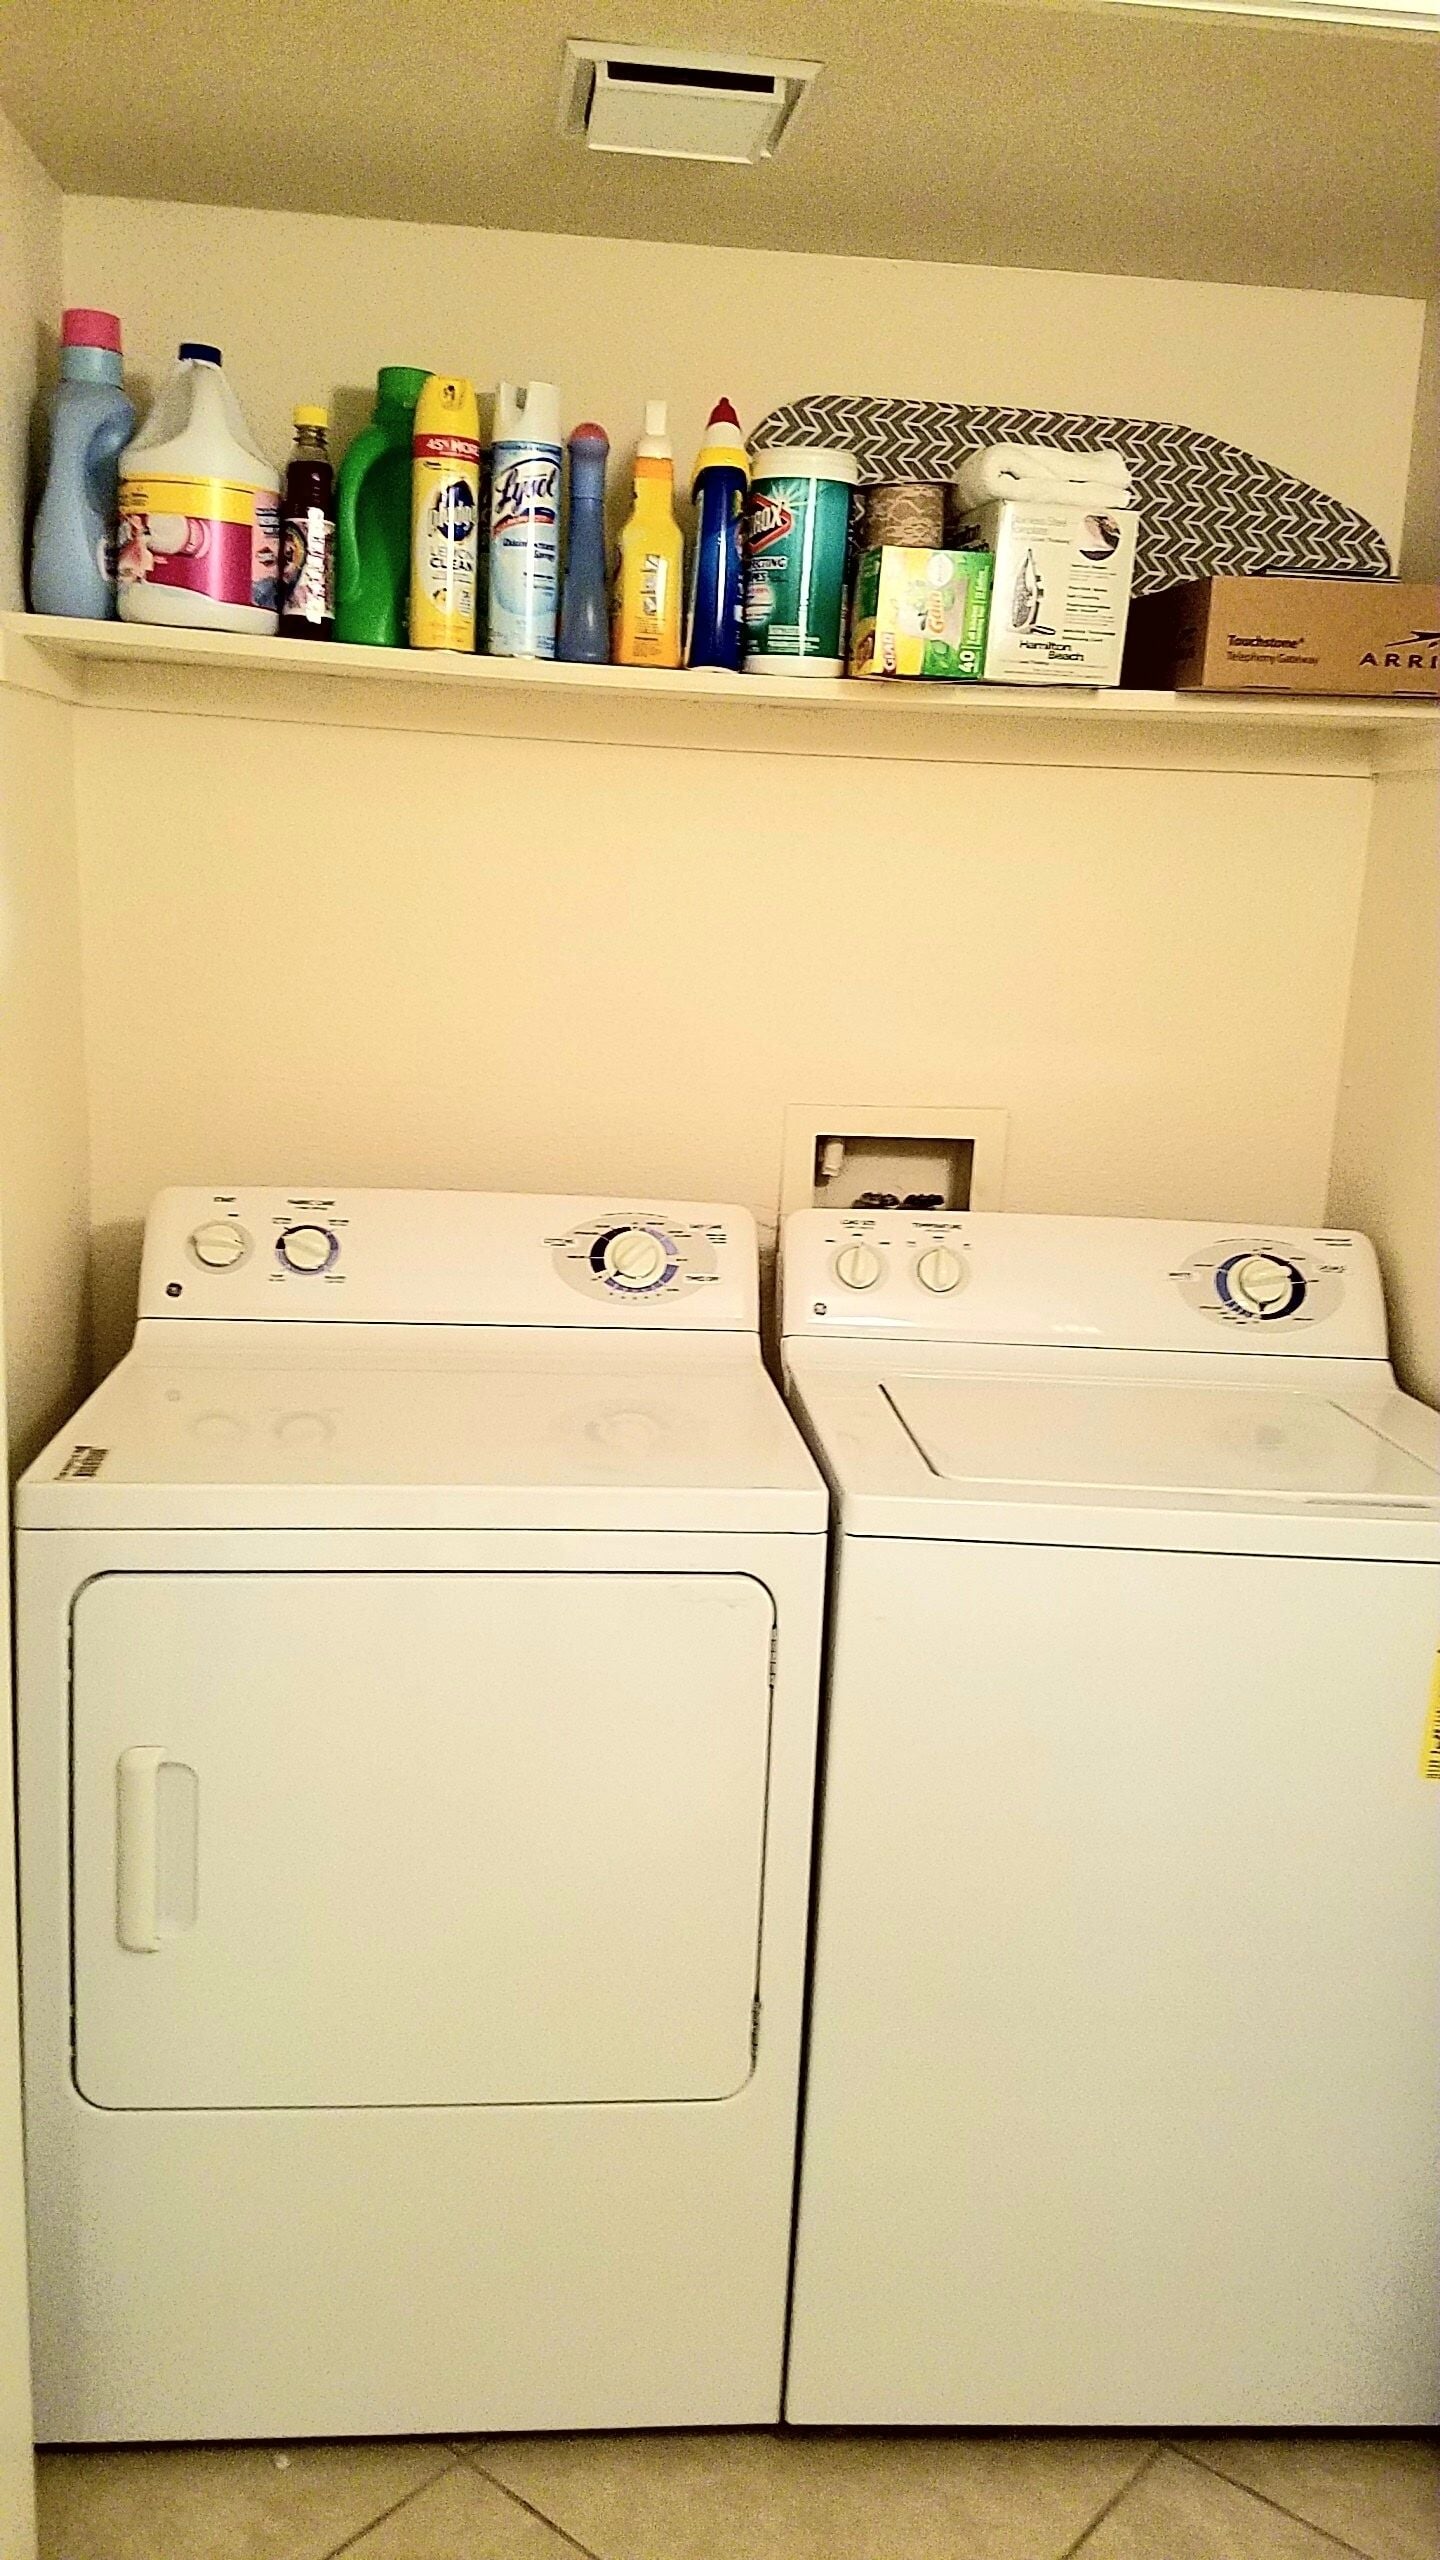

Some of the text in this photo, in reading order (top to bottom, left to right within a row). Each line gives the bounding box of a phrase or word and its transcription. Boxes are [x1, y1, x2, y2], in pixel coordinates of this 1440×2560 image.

[495, 467, 557, 514] Lysol
[1019, 640, 1073, 651] Hamilton
[958, 650, 976, 673] 40
[1048, 650, 1085, 662] Beach
[1359, 652, 1439, 669] ARRI
